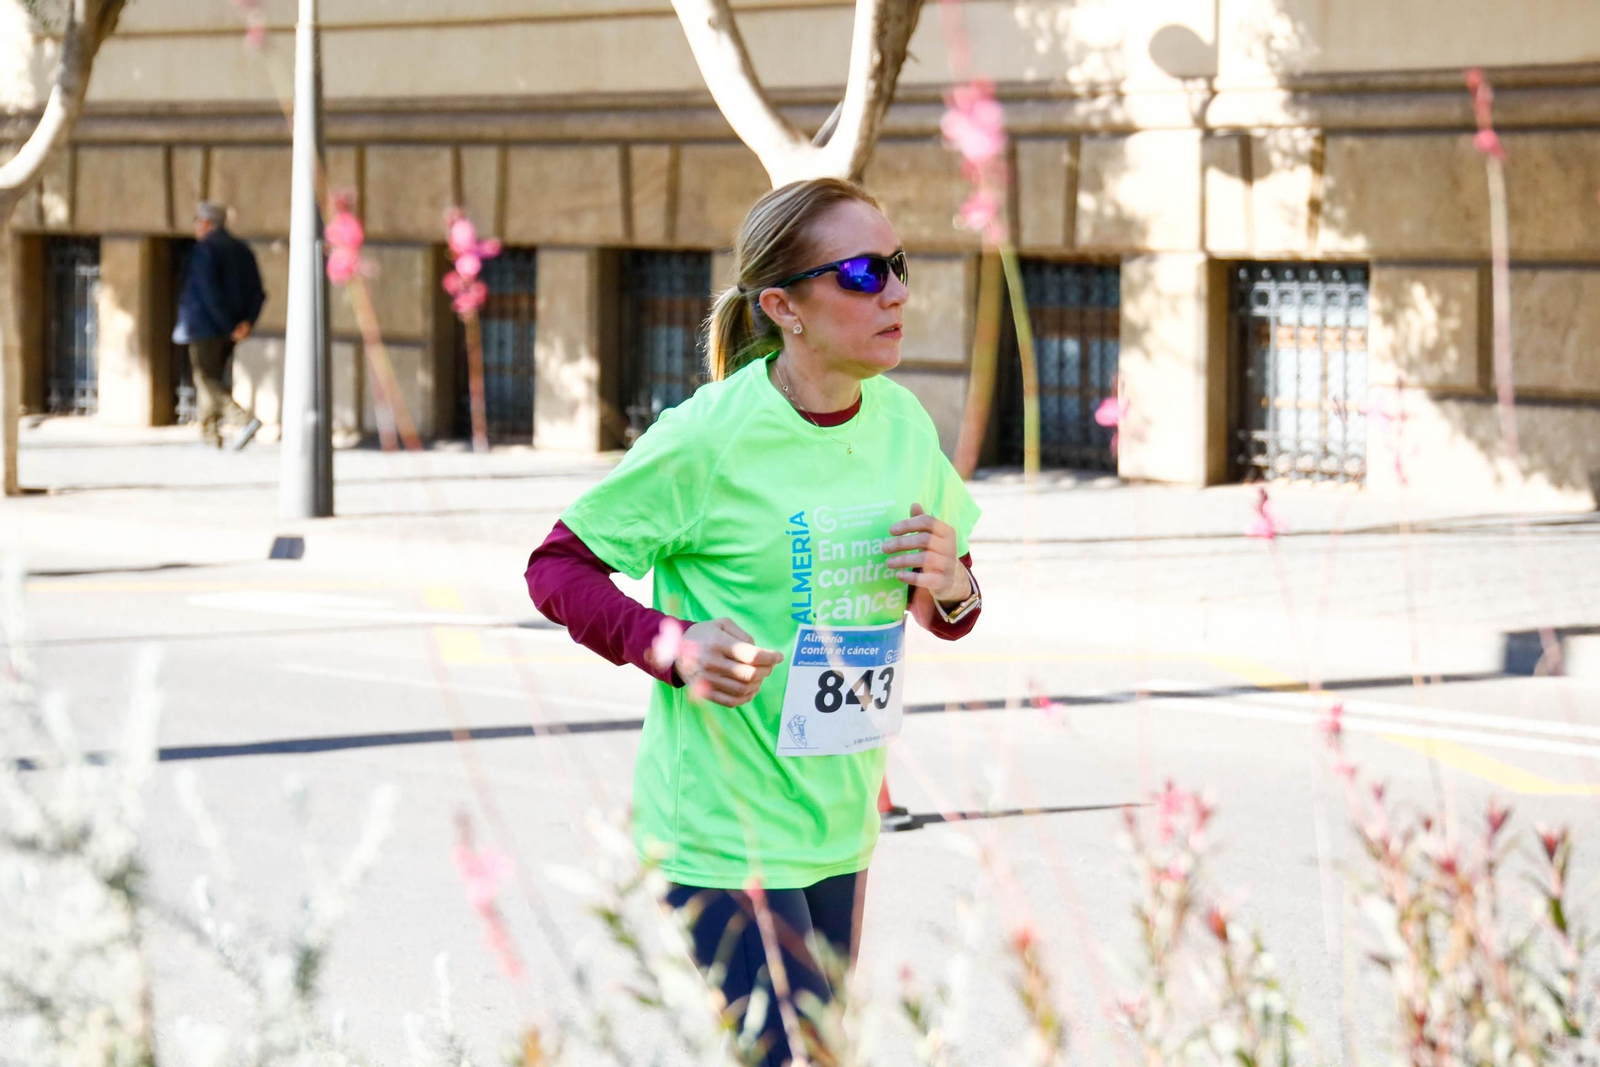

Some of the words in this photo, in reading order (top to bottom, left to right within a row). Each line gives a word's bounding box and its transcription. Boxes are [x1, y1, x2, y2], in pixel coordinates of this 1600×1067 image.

[817, 539, 846, 561] En
[785, 510, 813, 625] ALMERÍA
[818, 559, 897, 588] contra
[816, 586, 907, 621] cánce
[800, 645, 833, 655] contra
[835, 645, 845, 656] el
[847, 646, 879, 656] cáncer
[803, 632, 844, 644] Almería
[814, 666, 895, 714] 843
